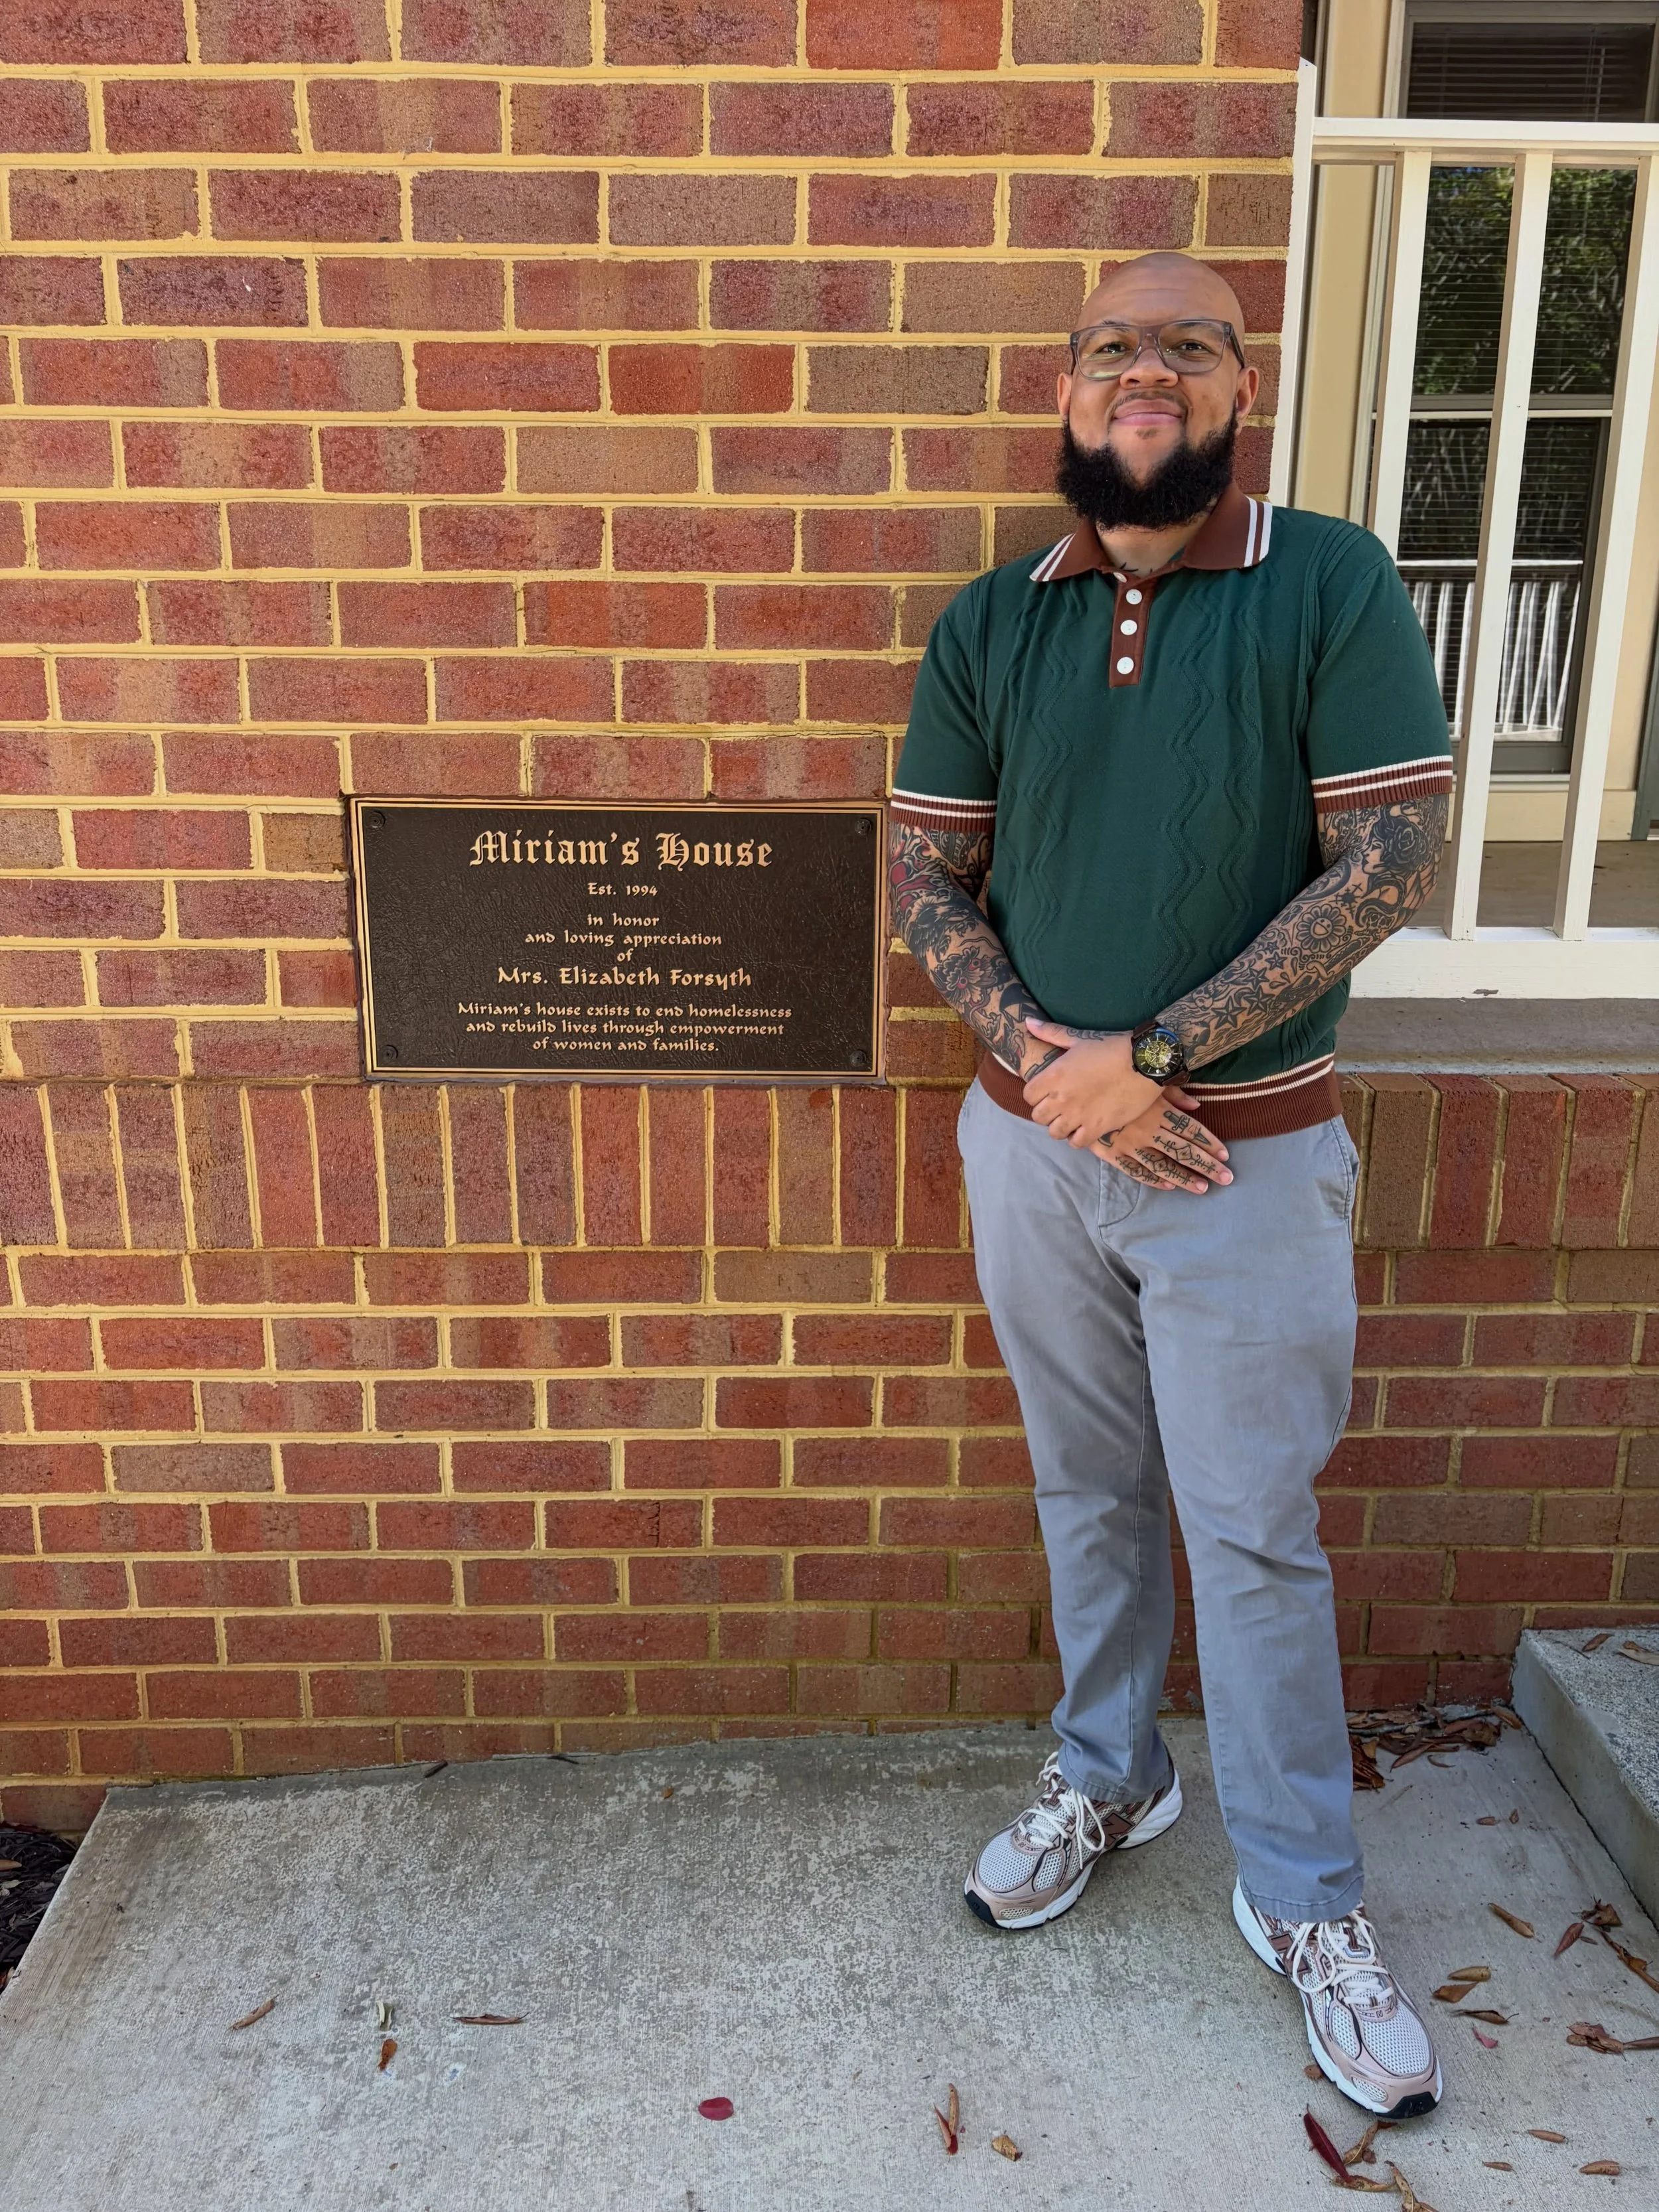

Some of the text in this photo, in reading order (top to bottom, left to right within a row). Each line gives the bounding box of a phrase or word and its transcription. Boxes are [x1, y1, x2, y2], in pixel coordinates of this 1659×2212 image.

[469, 829, 772, 872] Miriam's House
[587, 882, 658, 897] Est. 1994
[587, 912, 660, 926] in honor
[525, 929, 722, 948] and loving appreciation
[616, 948, 634, 962] of
[498, 965, 751, 991] Mrs. Elizabeth Forsyth
[458, 1001, 792, 1018] Miriam's house exists to end homelessness
[466, 1019, 784, 1037] and rebuild lives through empowerment
[532, 1036, 719, 1051] of women and families.
